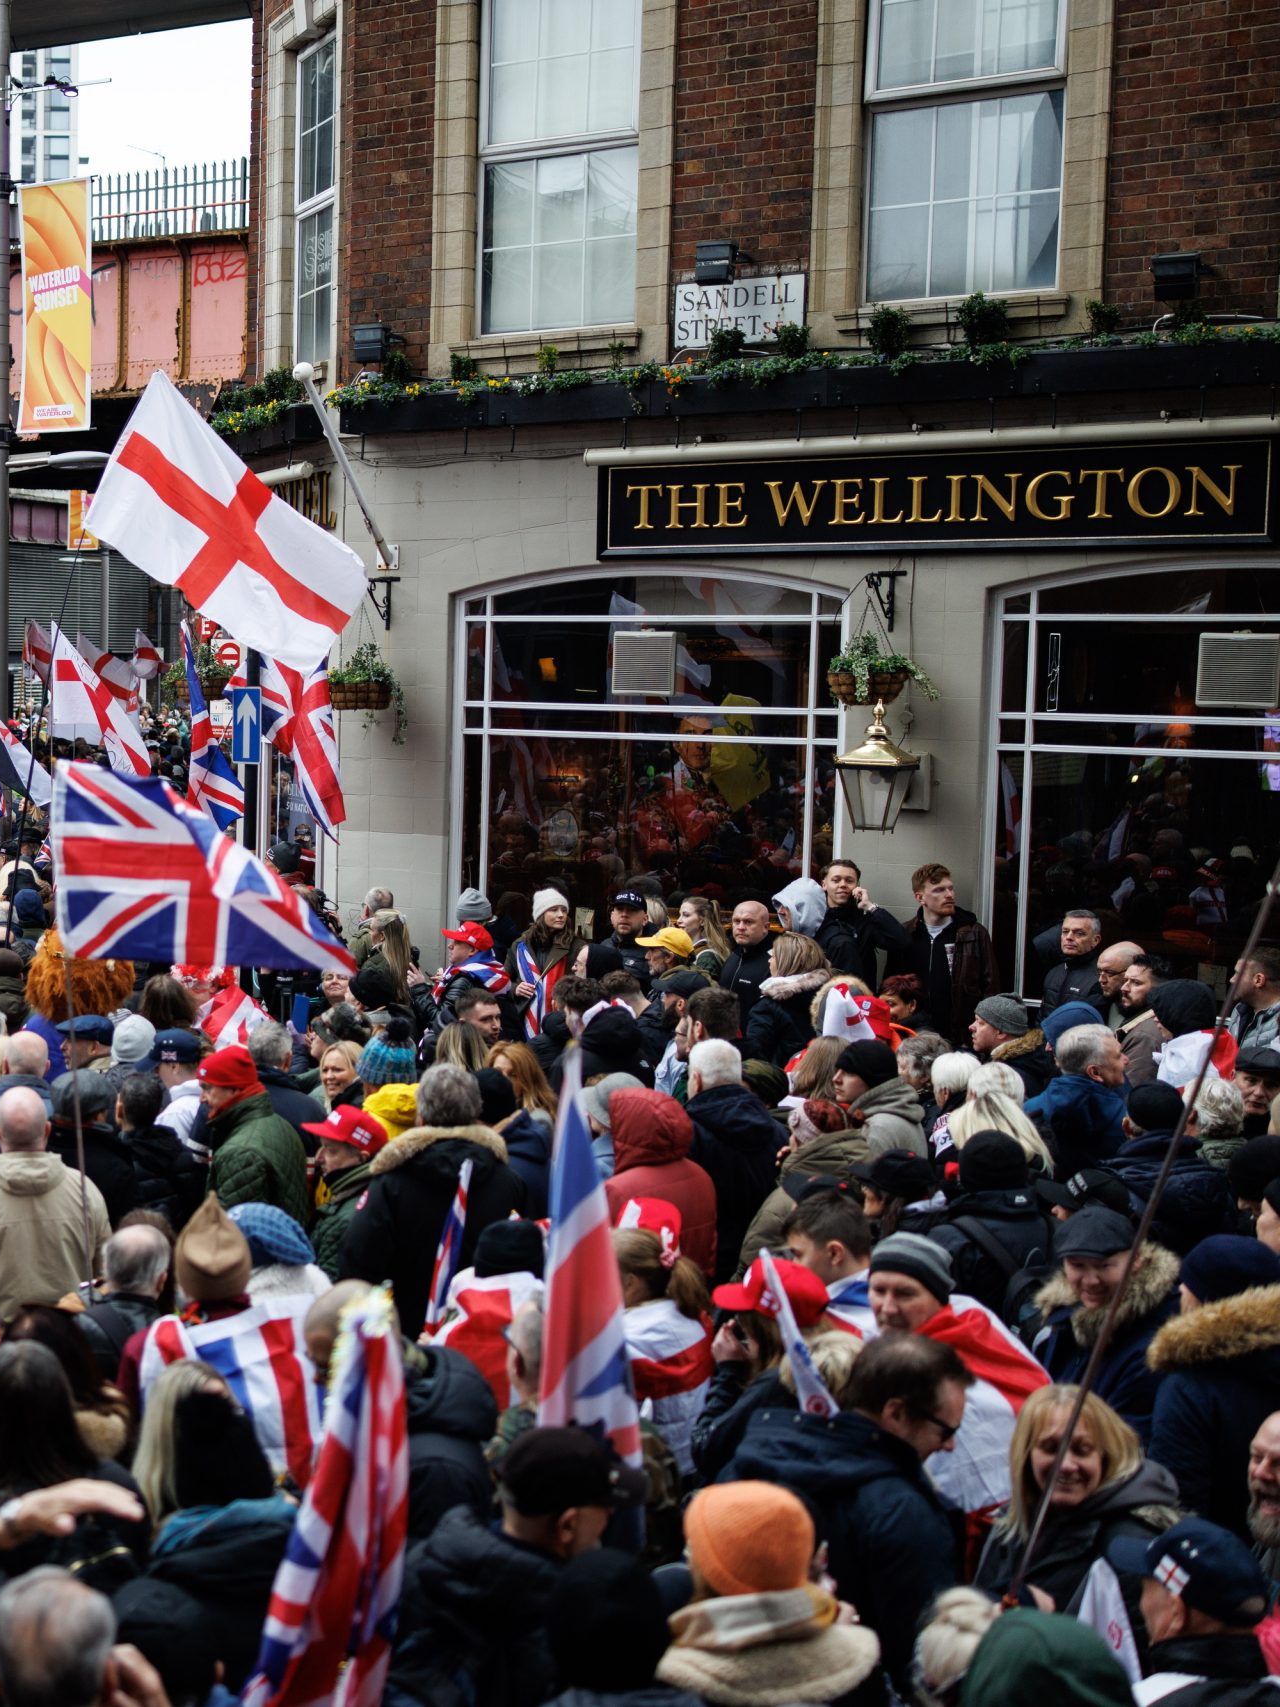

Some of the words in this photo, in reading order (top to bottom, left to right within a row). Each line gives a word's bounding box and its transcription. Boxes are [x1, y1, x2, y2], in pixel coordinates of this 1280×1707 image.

[28, 265, 80, 292] WATERLOO
[34, 285, 78, 313] SUNSET
[682, 283, 797, 312] SANDELL
[626, 483, 748, 529] THE
[764, 465, 1243, 528] WELLINGTON
